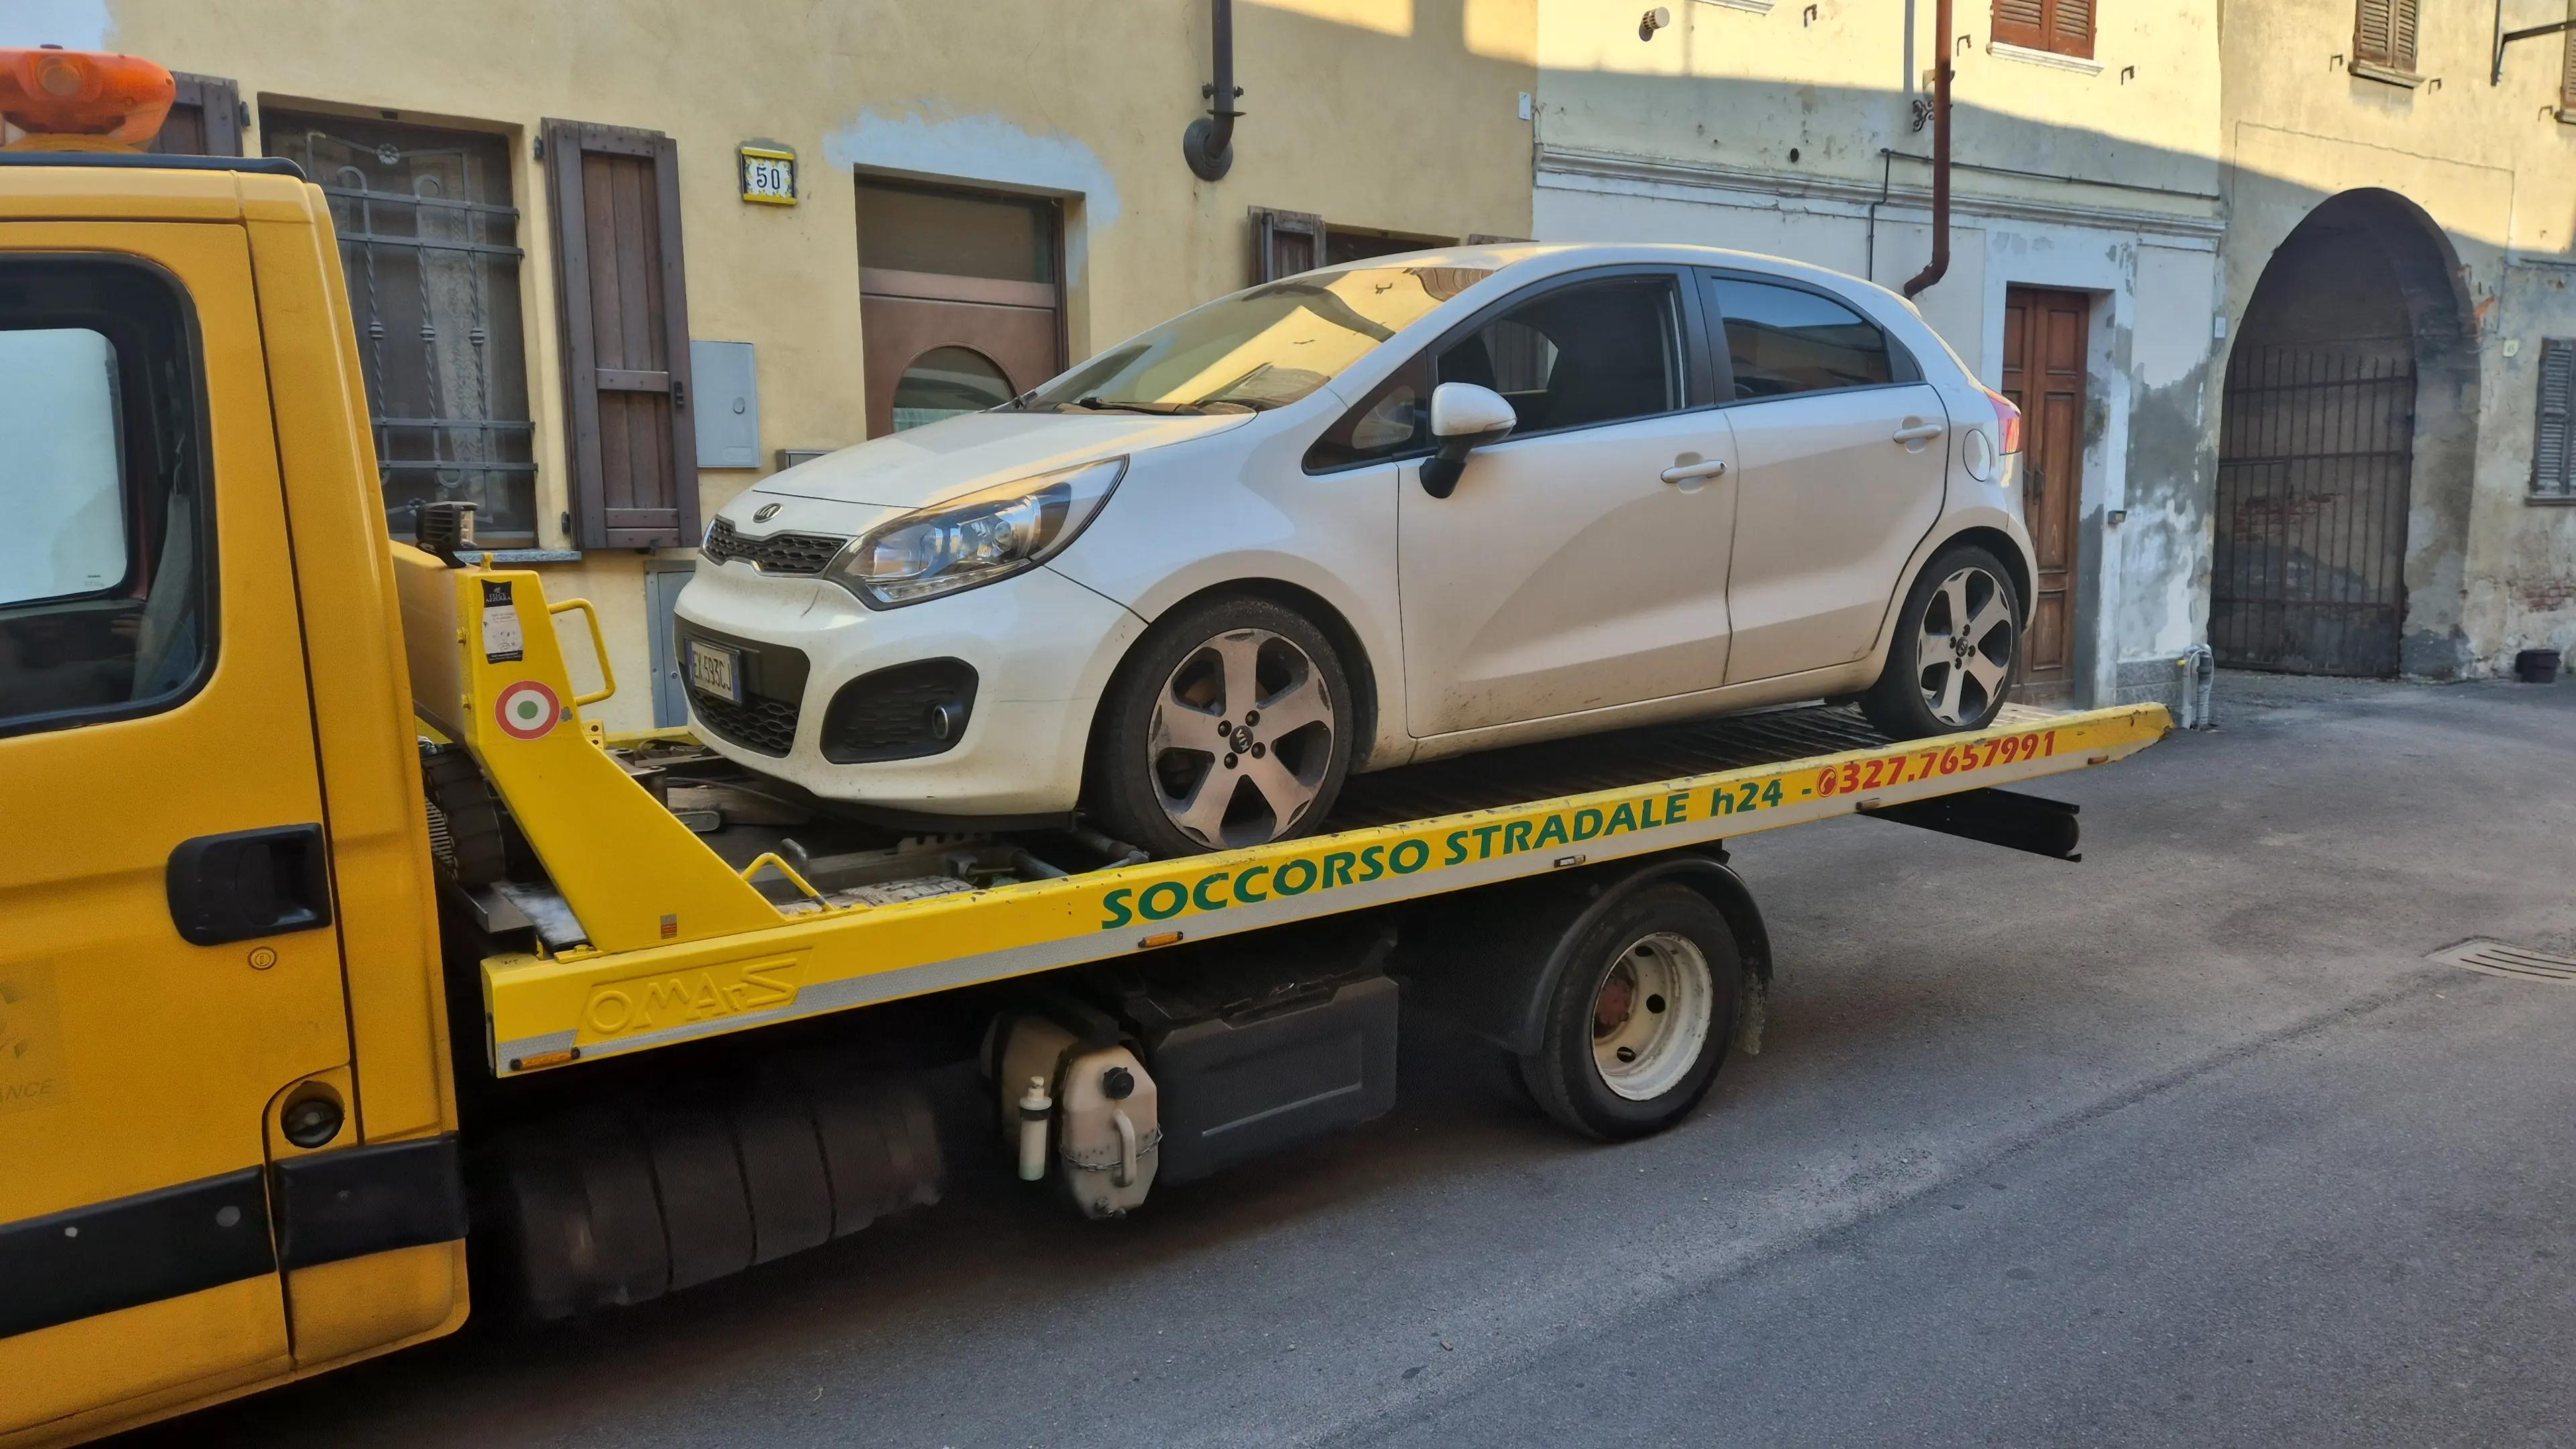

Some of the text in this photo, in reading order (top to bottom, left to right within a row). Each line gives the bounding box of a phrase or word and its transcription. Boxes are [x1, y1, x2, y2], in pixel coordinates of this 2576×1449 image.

[757, 166, 780, 190] 50
[1102, 839, 1430, 930] SOCCORSO
[1444, 792, 1689, 866] STRADALE
[1711, 778, 1783, 817] h24
[1839, 730, 2055, 794] 327.7657991
